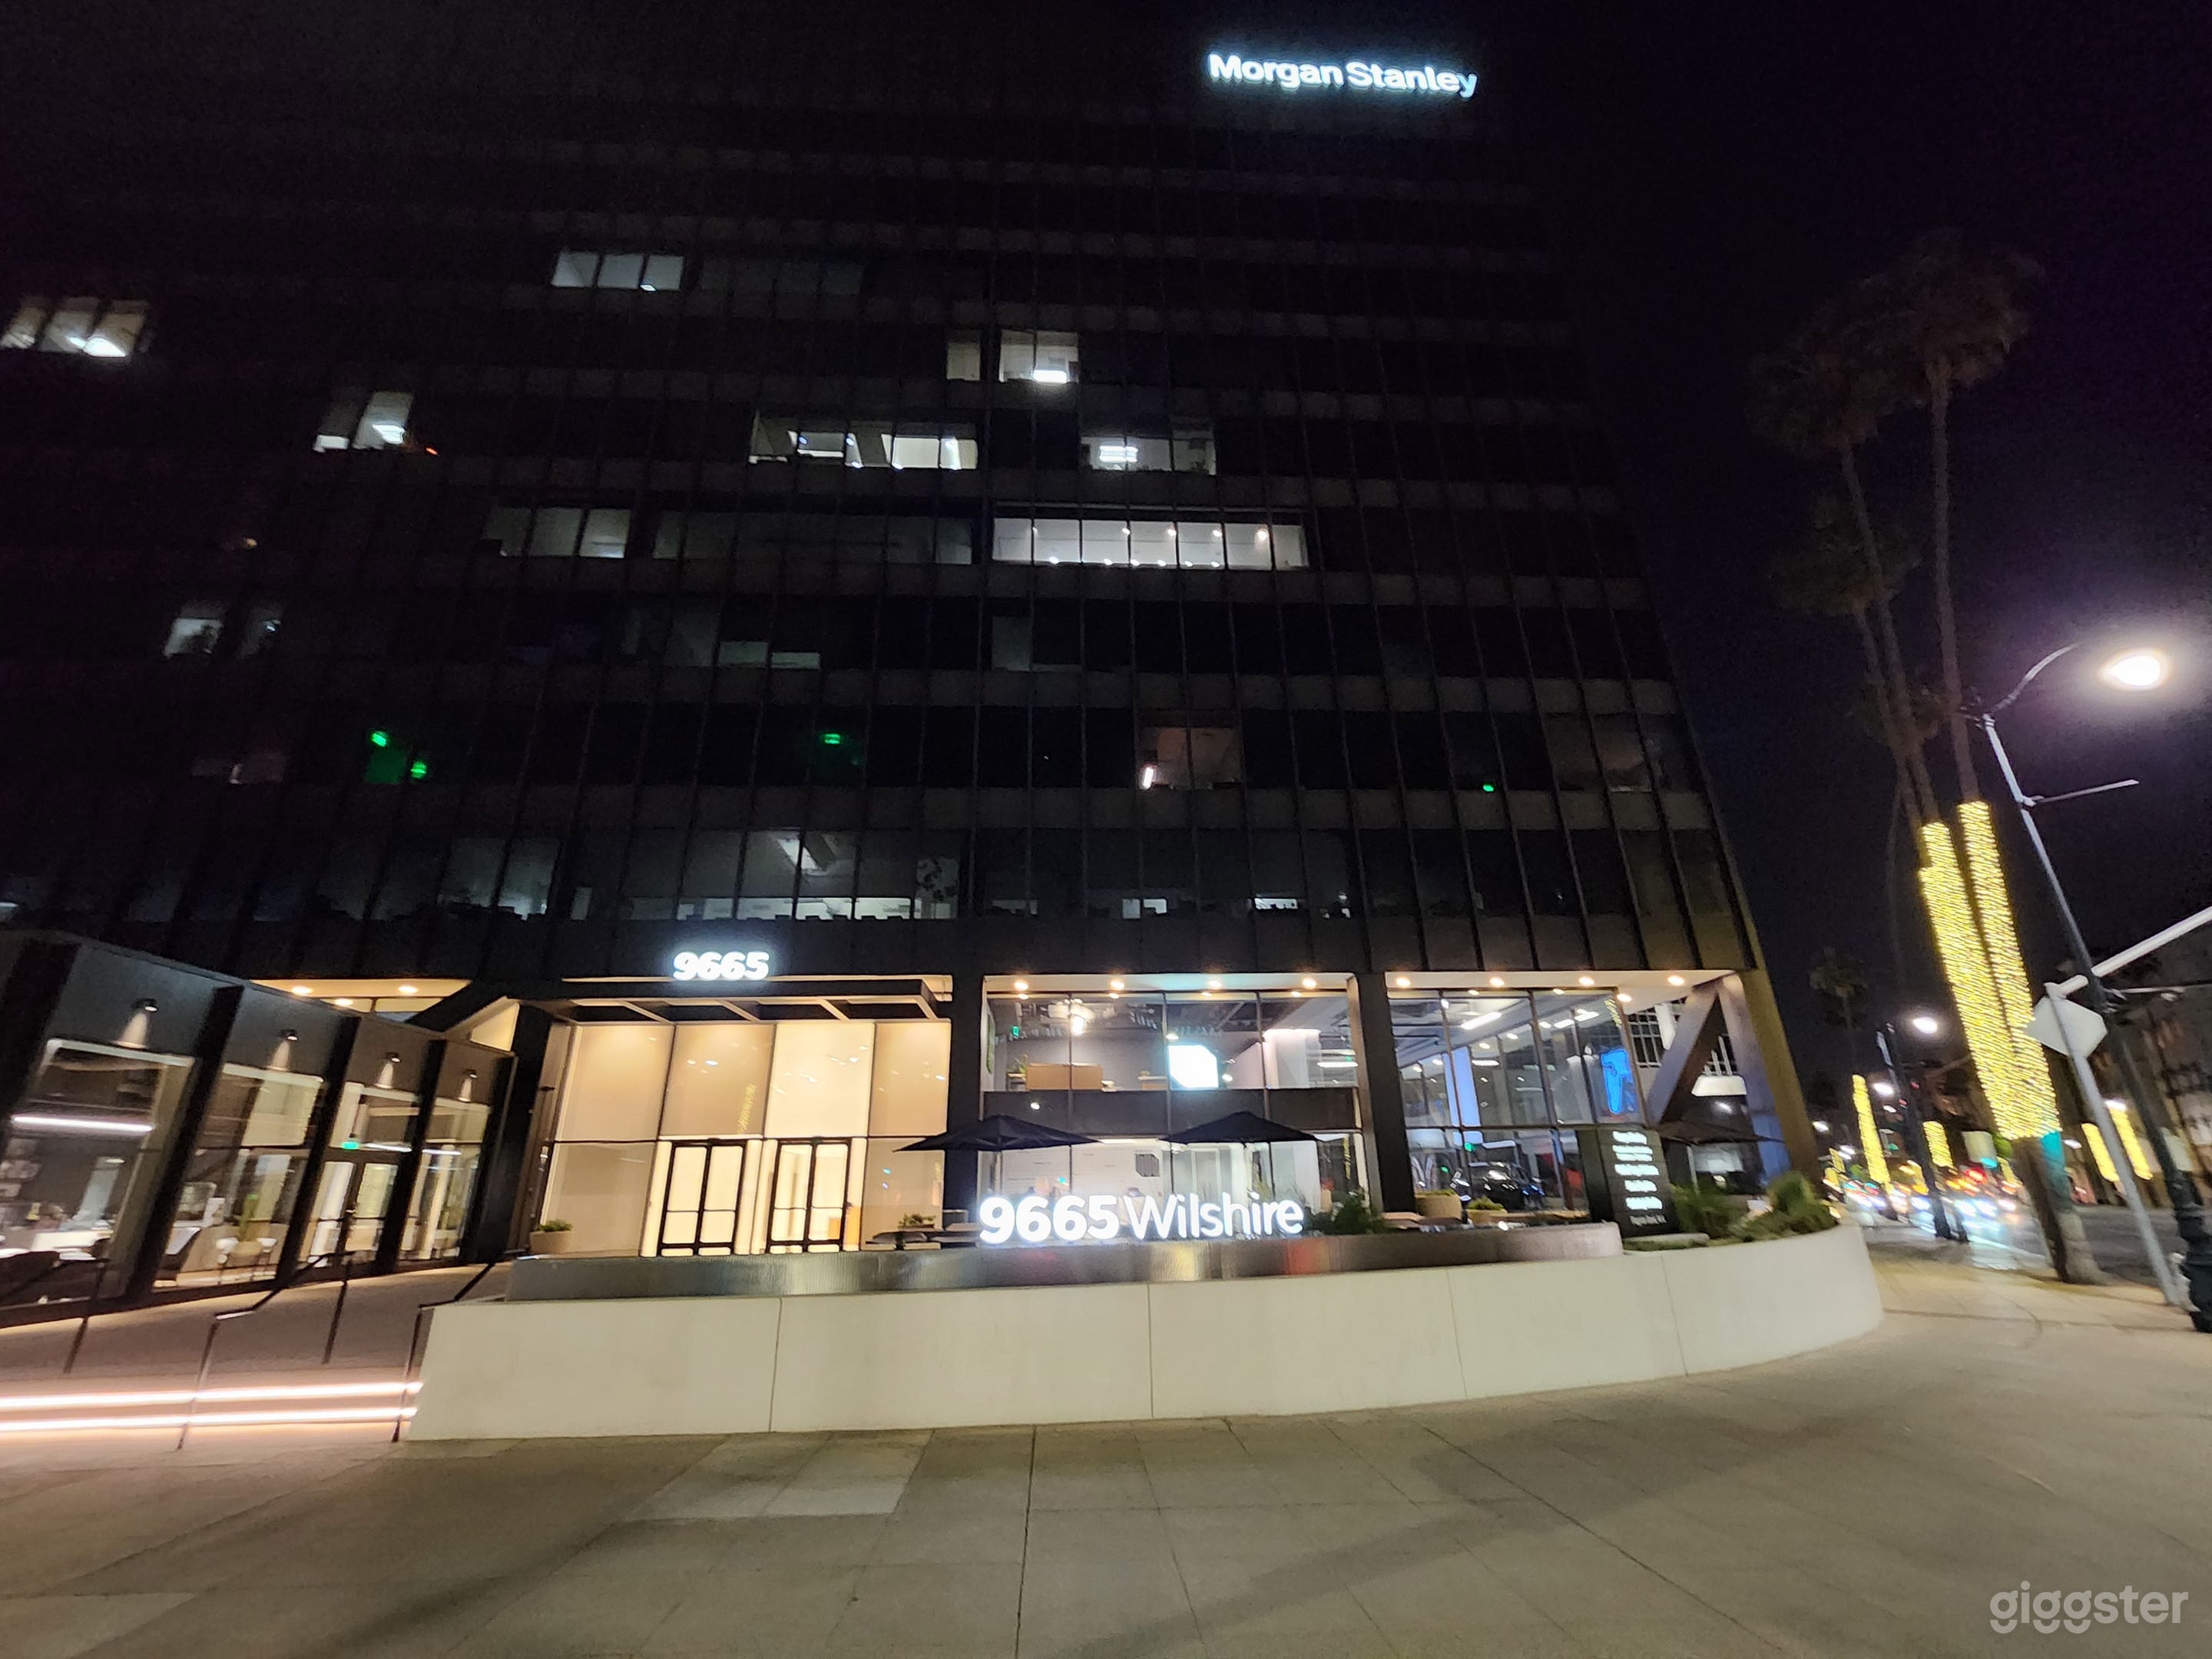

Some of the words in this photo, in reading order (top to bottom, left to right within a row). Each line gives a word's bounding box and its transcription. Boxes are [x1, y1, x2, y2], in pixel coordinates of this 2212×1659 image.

[1208, 53, 1343, 90] Morgan
[1346, 61, 1478, 98] Stanley
[673, 951, 770, 982] 9665
[979, 1195, 1120, 1243] 9665
[1124, 1191, 1304, 1240] Wilshire
